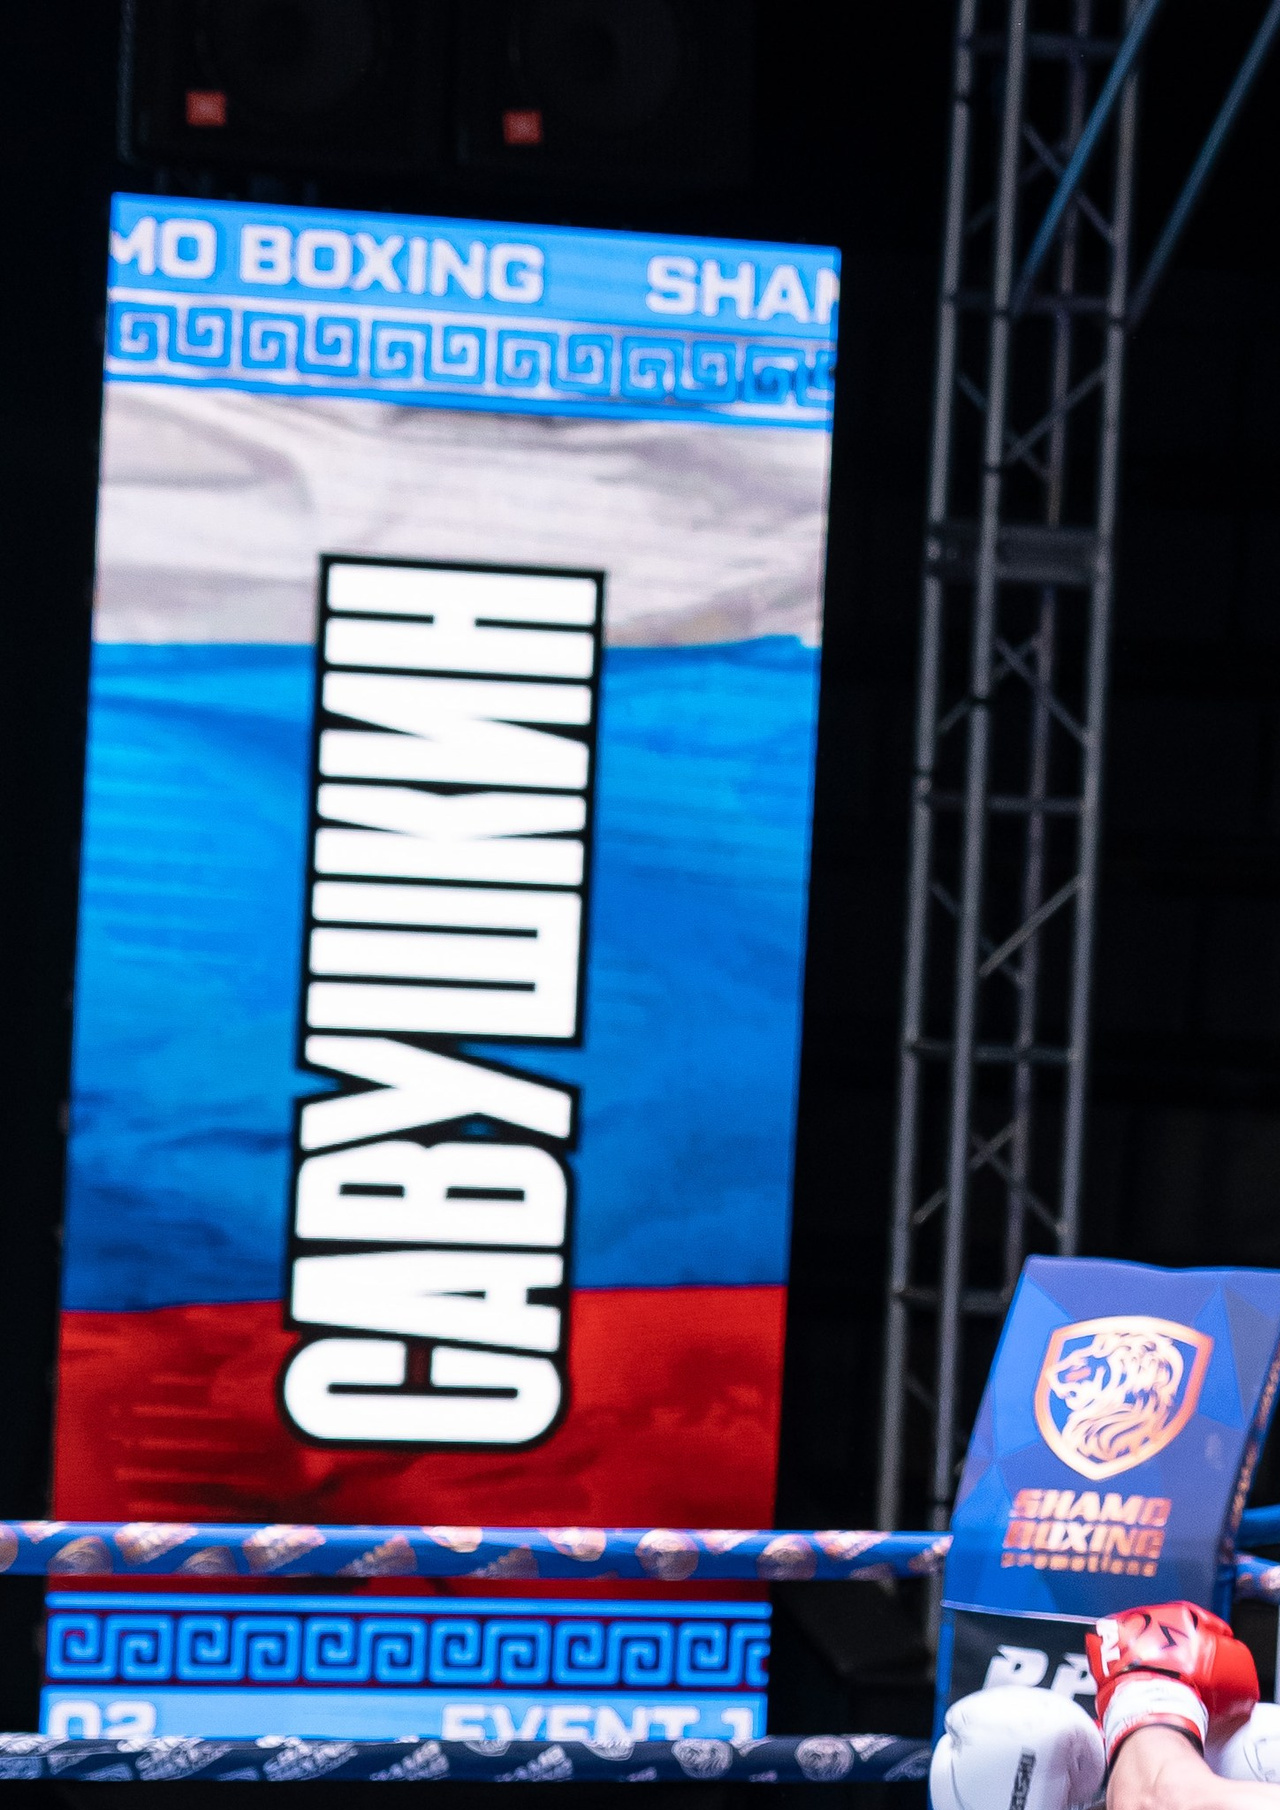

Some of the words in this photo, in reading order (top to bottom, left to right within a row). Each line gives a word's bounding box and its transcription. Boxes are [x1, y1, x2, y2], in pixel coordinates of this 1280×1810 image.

[240, 224, 544, 303] BOXING
[281, 560, 600, 1446] САВУШКИН
[441, 1704, 700, 1741] EVENT
